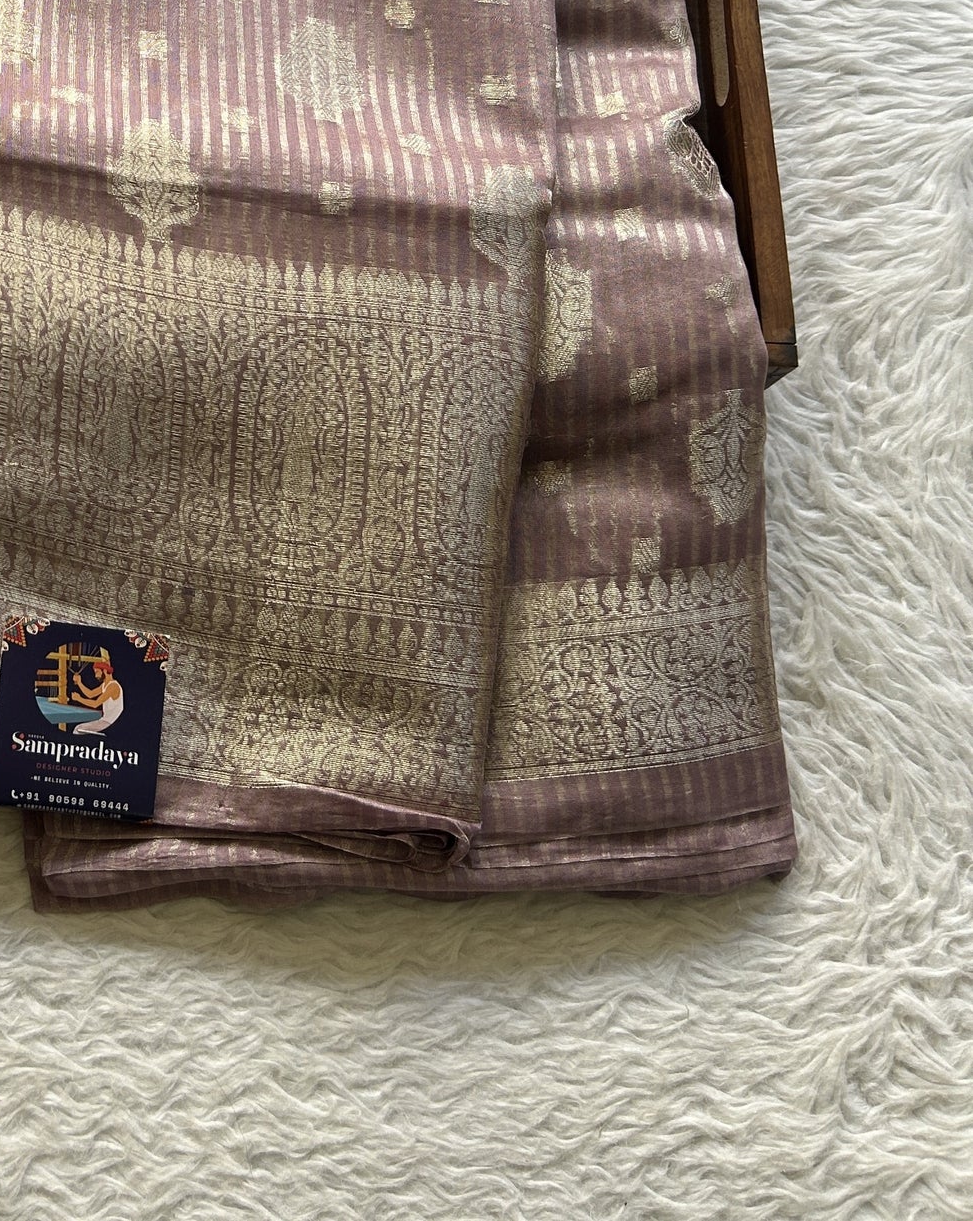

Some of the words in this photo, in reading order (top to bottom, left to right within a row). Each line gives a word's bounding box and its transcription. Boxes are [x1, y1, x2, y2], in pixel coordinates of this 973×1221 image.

[11, 731, 139, 769] Sampradaya
[36, 762, 78, 773] DESIGNER
[80, 767, 111, 777] STUDIO
[44, 776, 70, 785] BELIEVE
[19, 791, 40, 801] +91
[48, 794, 85, 806] 90598
[92, 799, 129, 812] 69444
